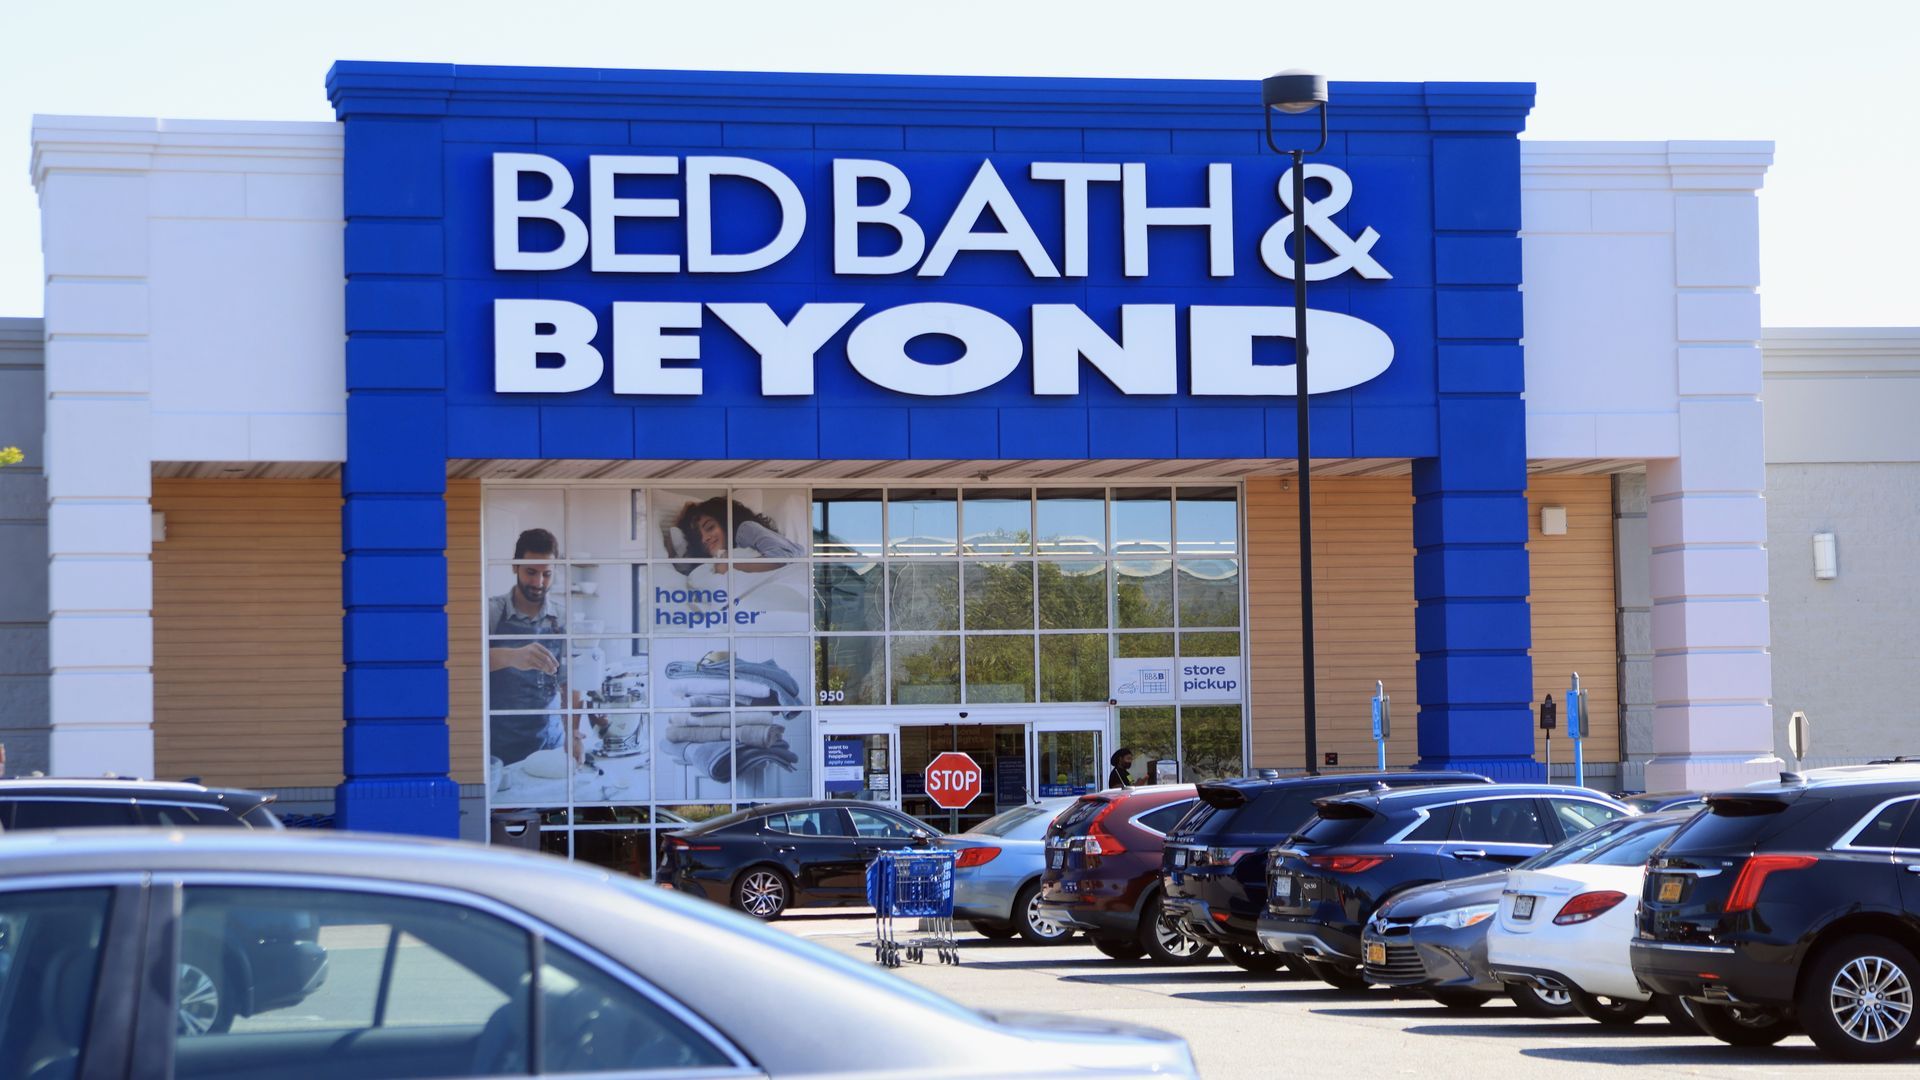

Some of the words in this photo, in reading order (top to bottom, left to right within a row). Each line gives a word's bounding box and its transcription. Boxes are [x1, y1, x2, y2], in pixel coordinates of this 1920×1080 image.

[492, 151, 808, 274] BED
[833, 157, 1235, 279] BATH
[1258, 163, 1394, 282] &
[493, 298, 1397, 397] BEYOND
[1144, 672, 1165, 680] BB&B
[1183, 664, 1226, 676] store
[1183, 678, 1237, 692] pickup
[819, 690, 844, 702] 950
[929, 770, 977, 791] STOP
